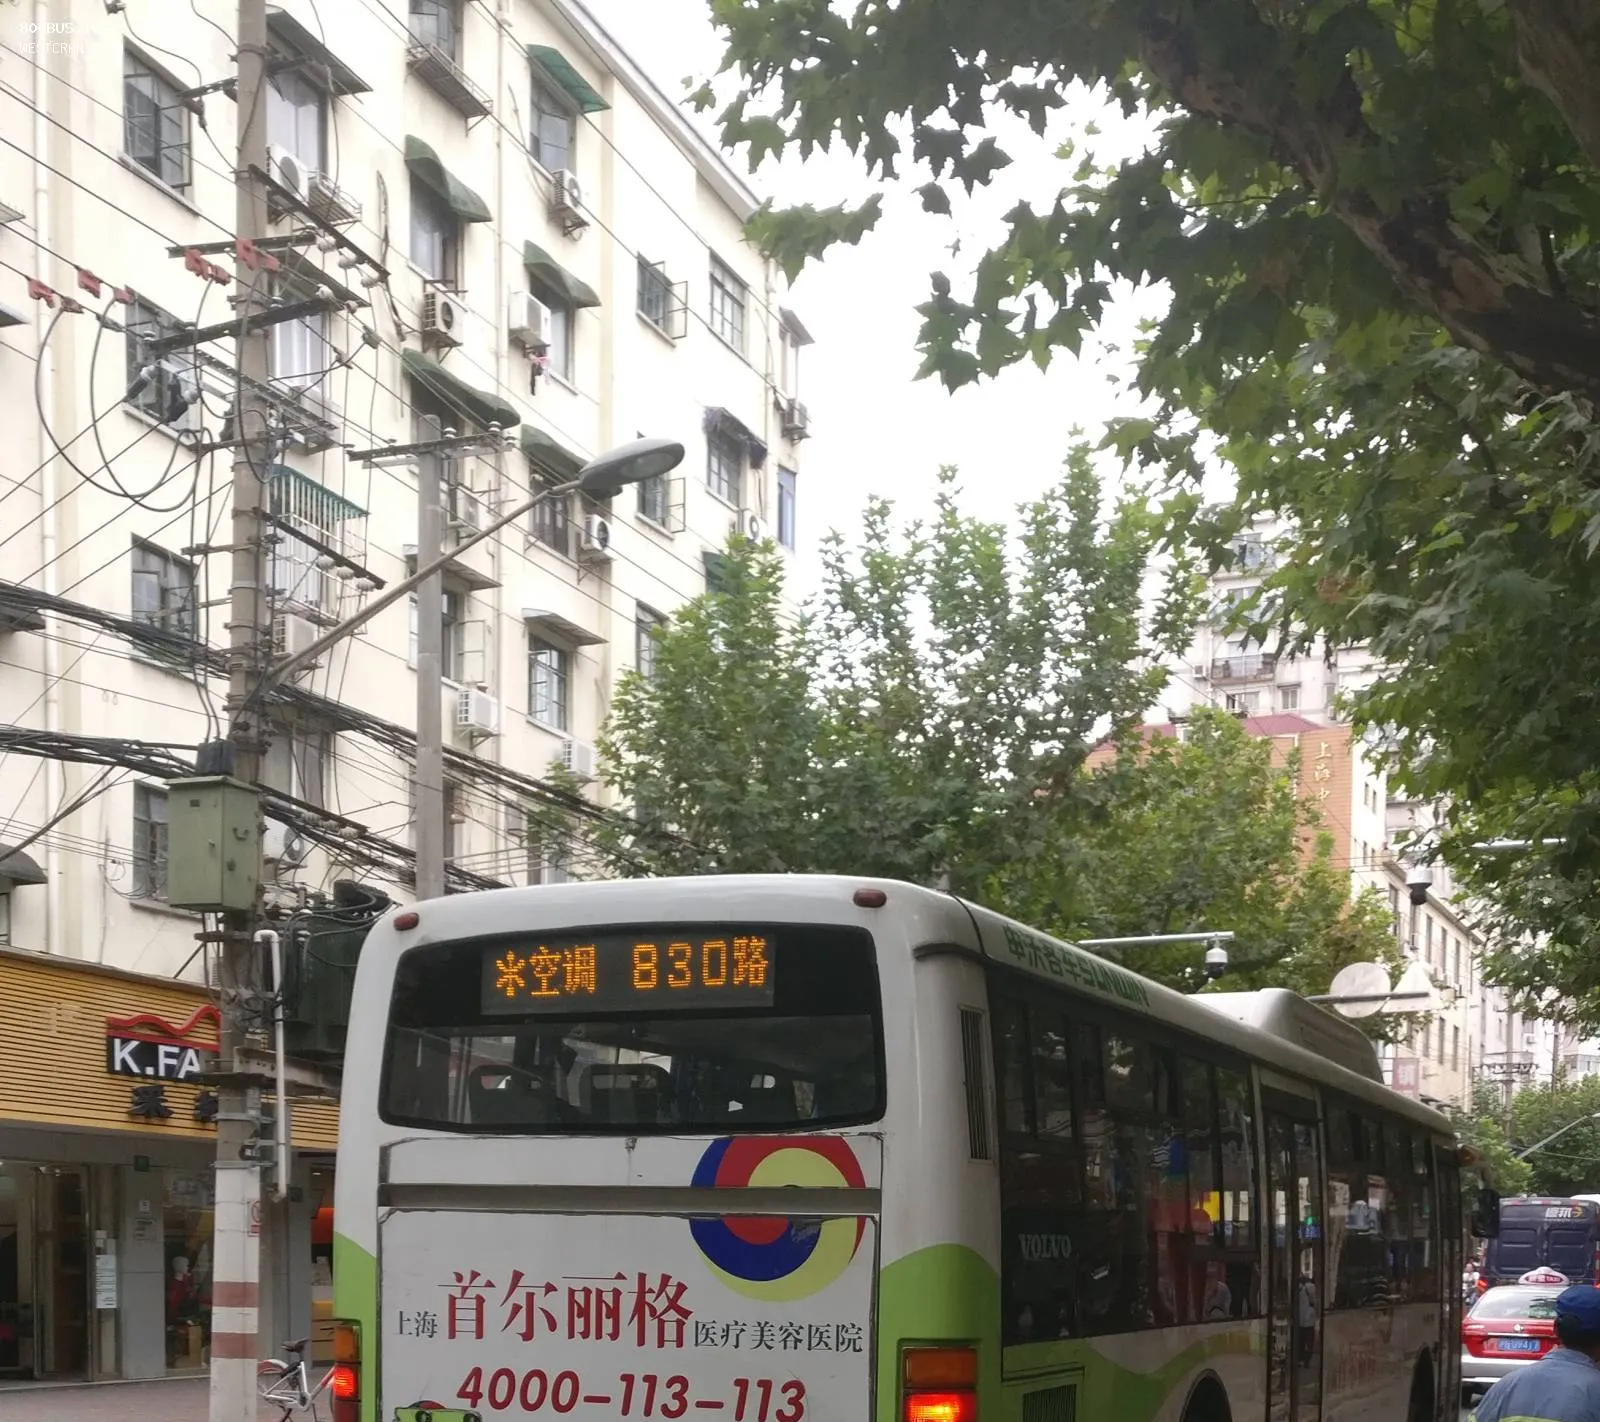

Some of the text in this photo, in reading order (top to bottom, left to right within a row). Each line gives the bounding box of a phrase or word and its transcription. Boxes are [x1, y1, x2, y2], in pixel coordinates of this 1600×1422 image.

[632, 936, 768, 989] 830路
[1018, 1233, 1072, 1259] VOLVO
[393, 1268, 864, 1354] 上海 首尔丽格 医疗美容医院
